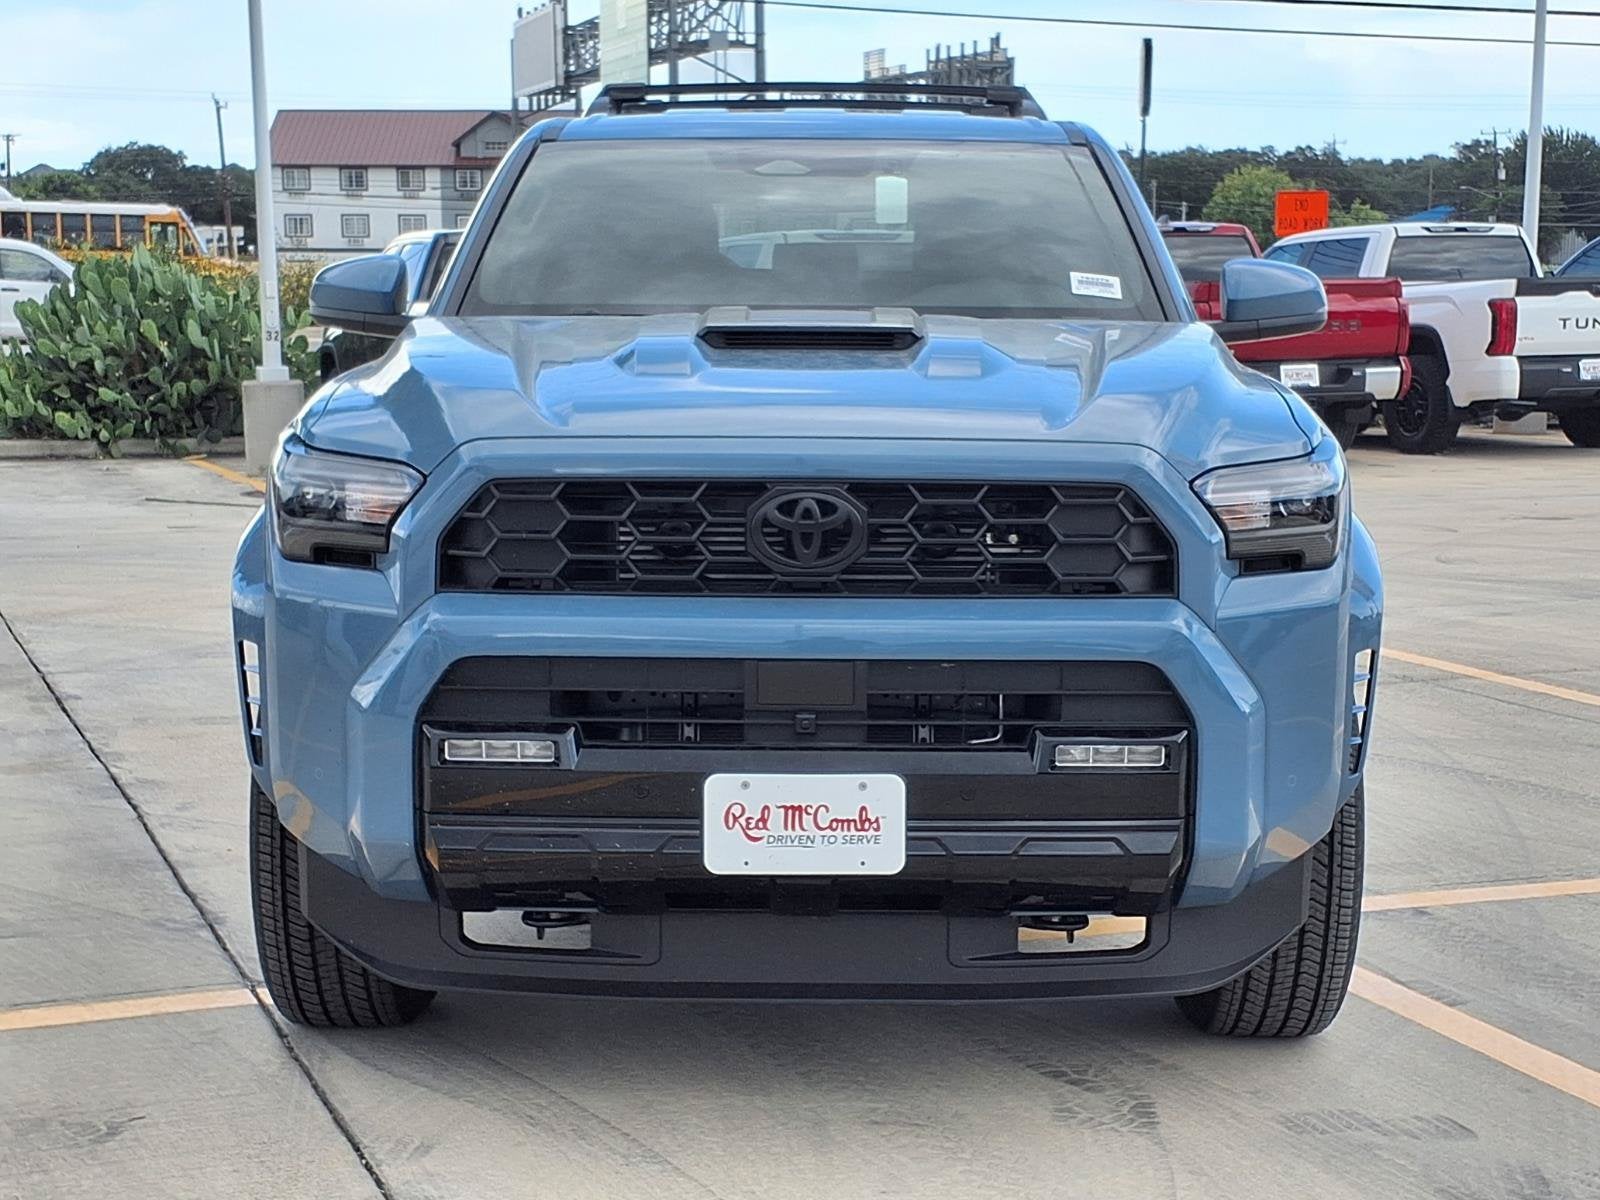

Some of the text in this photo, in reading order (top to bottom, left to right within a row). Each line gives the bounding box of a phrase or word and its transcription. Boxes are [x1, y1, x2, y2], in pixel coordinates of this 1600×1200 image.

[265, 330, 280, 342] 32
[723, 802, 882, 843] Red McCombs
[766, 834, 882, 846] DRIVEN TO SERVE
